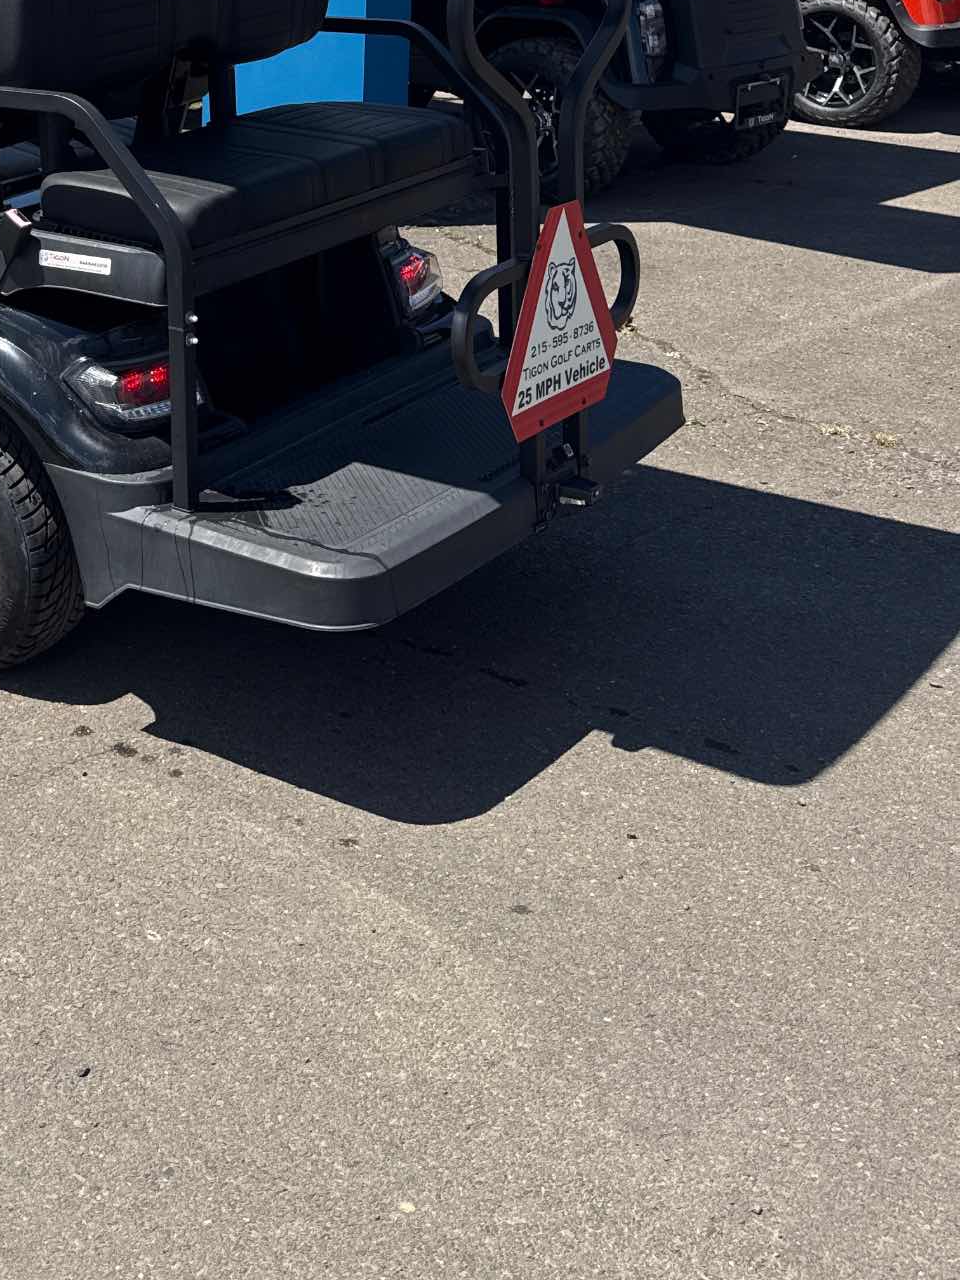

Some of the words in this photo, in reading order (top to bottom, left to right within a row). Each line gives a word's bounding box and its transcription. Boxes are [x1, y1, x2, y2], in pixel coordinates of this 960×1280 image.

[522, 361, 549, 380] TIGON
[550, 350, 573, 368] GOLF
[574, 338, 601, 357] CARTS
[530, 321, 595, 358] 215-595-8736
[518, 387, 532, 409] 25
[535, 372, 561, 400] MPH
[564, 355, 606, 385] Vehicle
